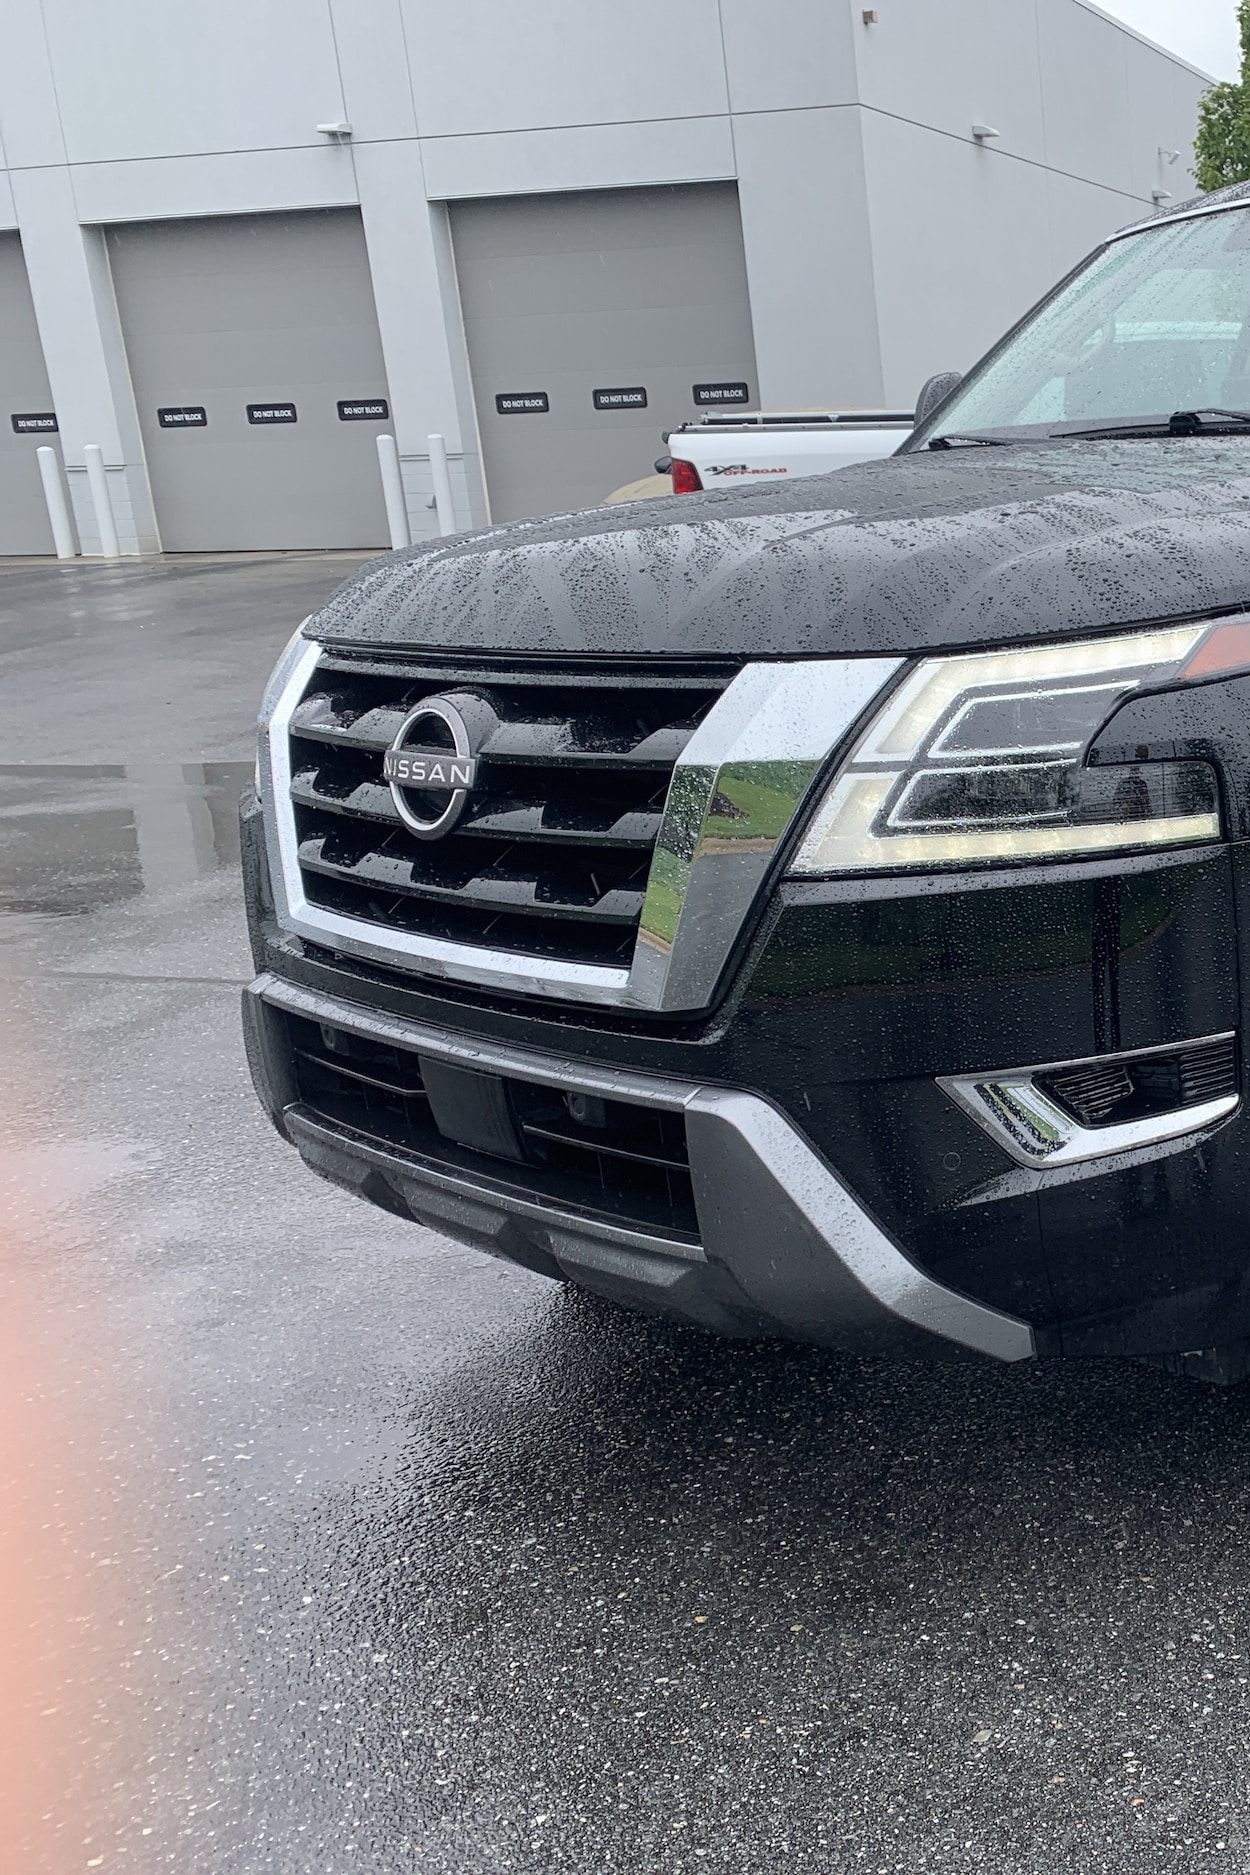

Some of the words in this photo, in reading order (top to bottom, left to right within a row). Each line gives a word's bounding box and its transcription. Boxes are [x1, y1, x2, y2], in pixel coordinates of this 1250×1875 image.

[700, 391, 710, 399] DO
[710, 390, 723, 398] NOT
[723, 389, 744, 398] BLOCK
[502, 400, 512, 408] DO
[511, 400, 524, 408] NOT
[524, 399, 544, 407] BLOCK
[600, 395, 609, 404] DO
[609, 395, 622, 403] NOT
[622, 394, 642, 402] BLOCK
[261, 410, 274, 418] NOT
[343, 407, 353, 415] DO
[364, 406, 383, 414] BLOCK
[164, 414, 173, 422] DO
[722, 467, 788, 477] OFF-ROAD
[383, 756, 471, 784] NISSAN
